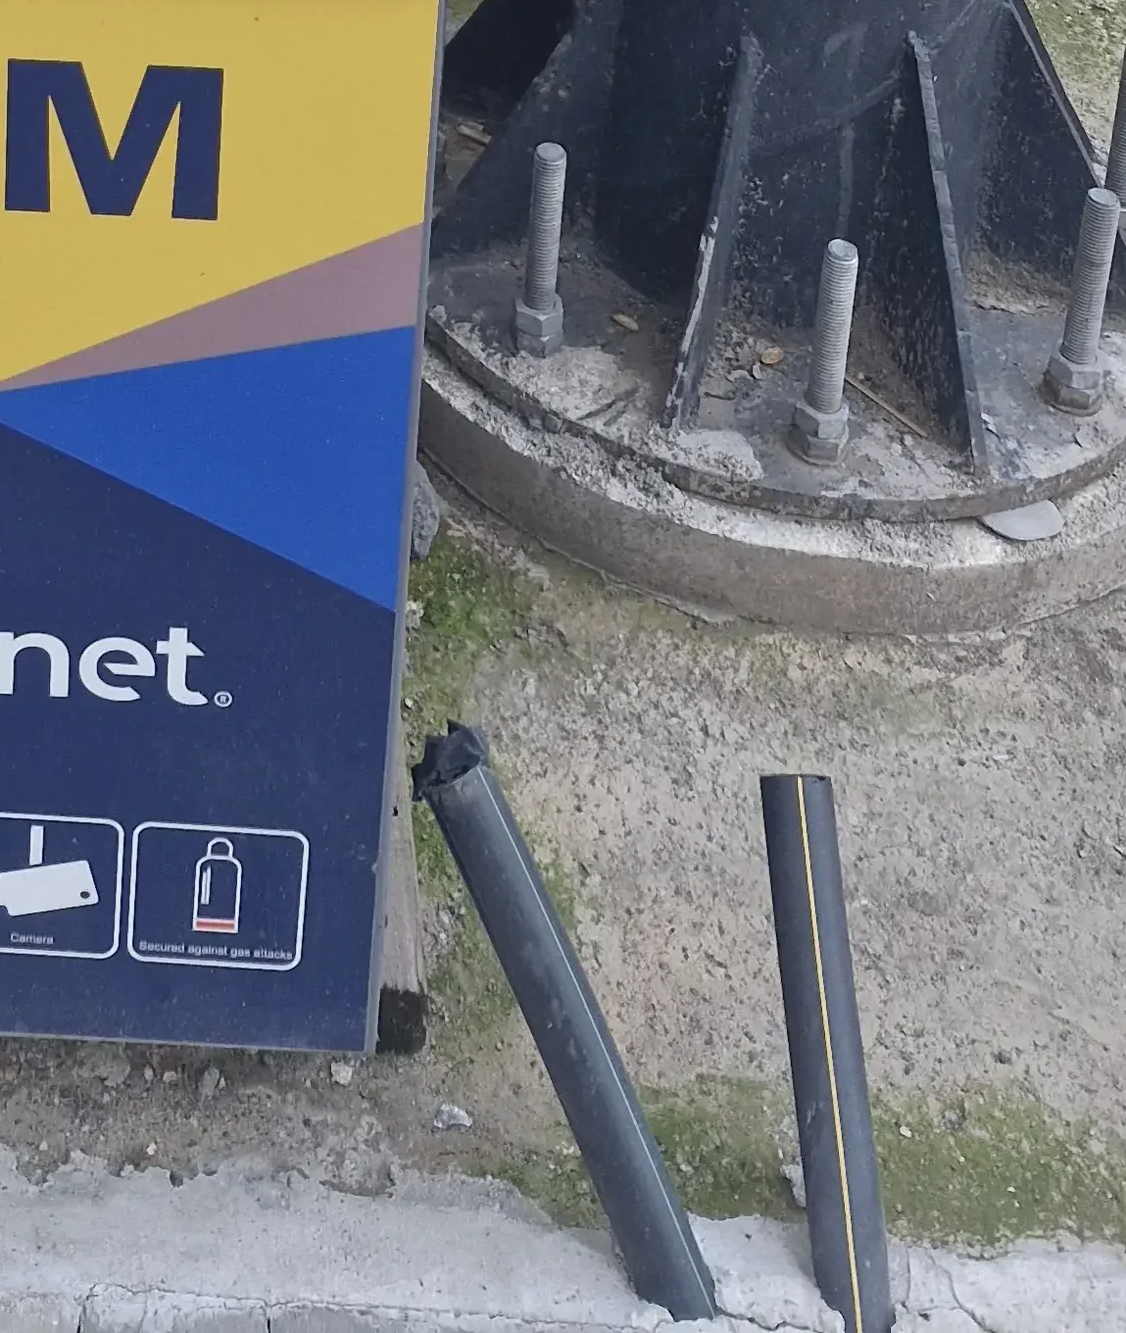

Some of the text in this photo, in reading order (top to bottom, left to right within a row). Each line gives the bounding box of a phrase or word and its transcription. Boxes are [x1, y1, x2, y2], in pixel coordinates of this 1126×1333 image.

[10, 932, 54, 945] Camera
[138, 939, 293, 961] Secured against gas attacks
